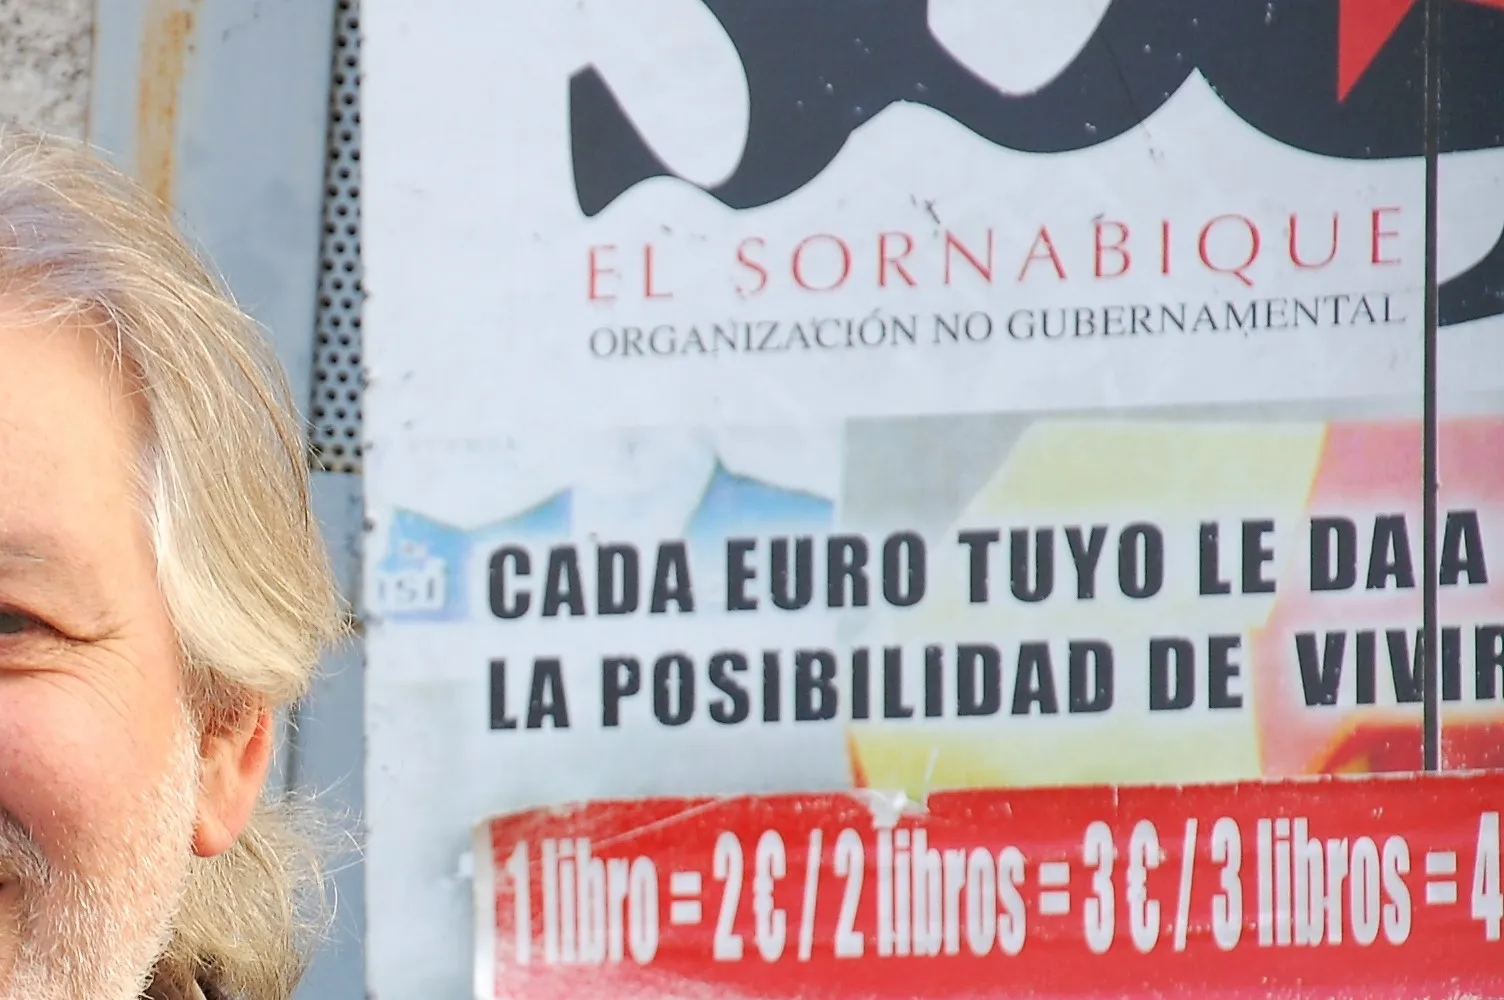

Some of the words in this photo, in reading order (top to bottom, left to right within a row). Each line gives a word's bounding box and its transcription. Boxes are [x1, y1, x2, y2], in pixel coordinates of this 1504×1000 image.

[587, 243, 674, 301] EL
[735, 206, 1402, 298] SORNABIQUE
[588, 308, 918, 358] ORGANIZACIÓN
[932, 312, 992, 344] NO
[1006, 293, 1406, 341] GUBERNAMENTAL
[488, 540, 695, 620] CADA
[726, 531, 927, 612] EURO
[958, 521, 1164, 603] TUYO
[1199, 517, 1277, 596] LE
[1309, 513, 1416, 592] DA
[1438, 509, 1489, 587] A
[488, 657, 571, 731] LA
[601, 638, 1114, 728] POSIBILIDAD
[1149, 635, 1244, 712] DE
[508, 839, 532, 966] 1
[541, 837, 660, 966] libro
[877, 826, 1027, 961] libros
[1257, 815, 1412, 948] libros
